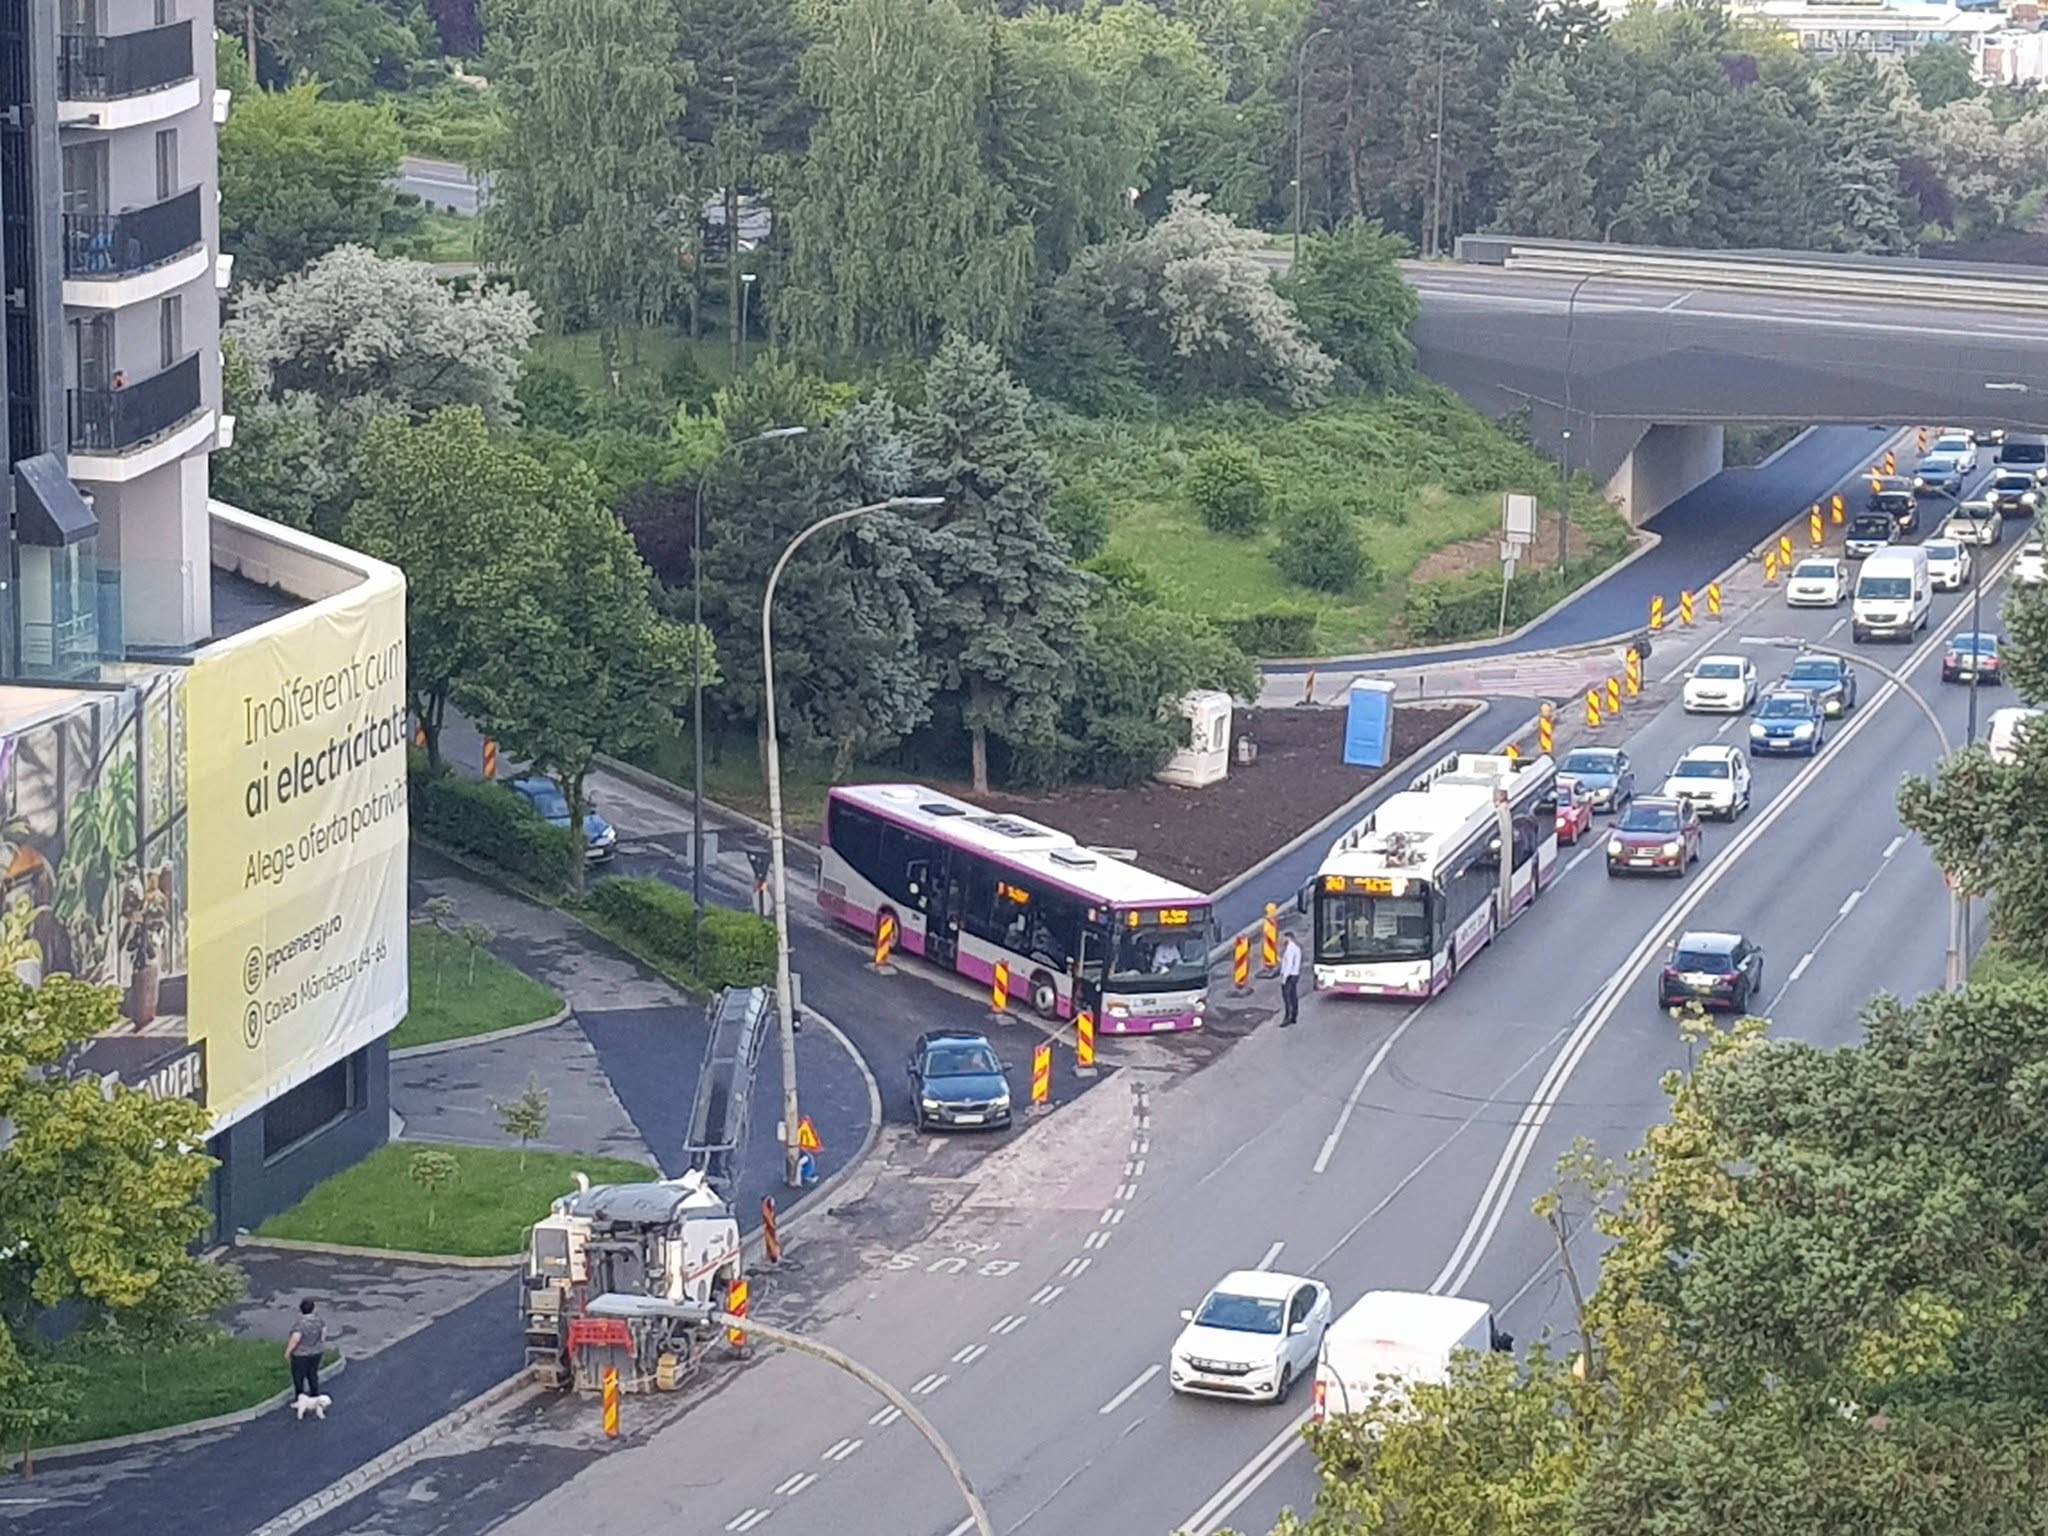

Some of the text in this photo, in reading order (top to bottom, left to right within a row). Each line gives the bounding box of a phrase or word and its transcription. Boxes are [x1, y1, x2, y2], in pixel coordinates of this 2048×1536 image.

[244, 640, 402, 746] Indiferent cum
[246, 761, 269, 818] ai
[245, 843, 295, 889] Alege
[299, 813, 348, 862] oferta
[265, 914, 342, 979] ppcenergy.ro
[265, 991, 298, 1025] Calea
[886, 1253, 1021, 1277] BUS
